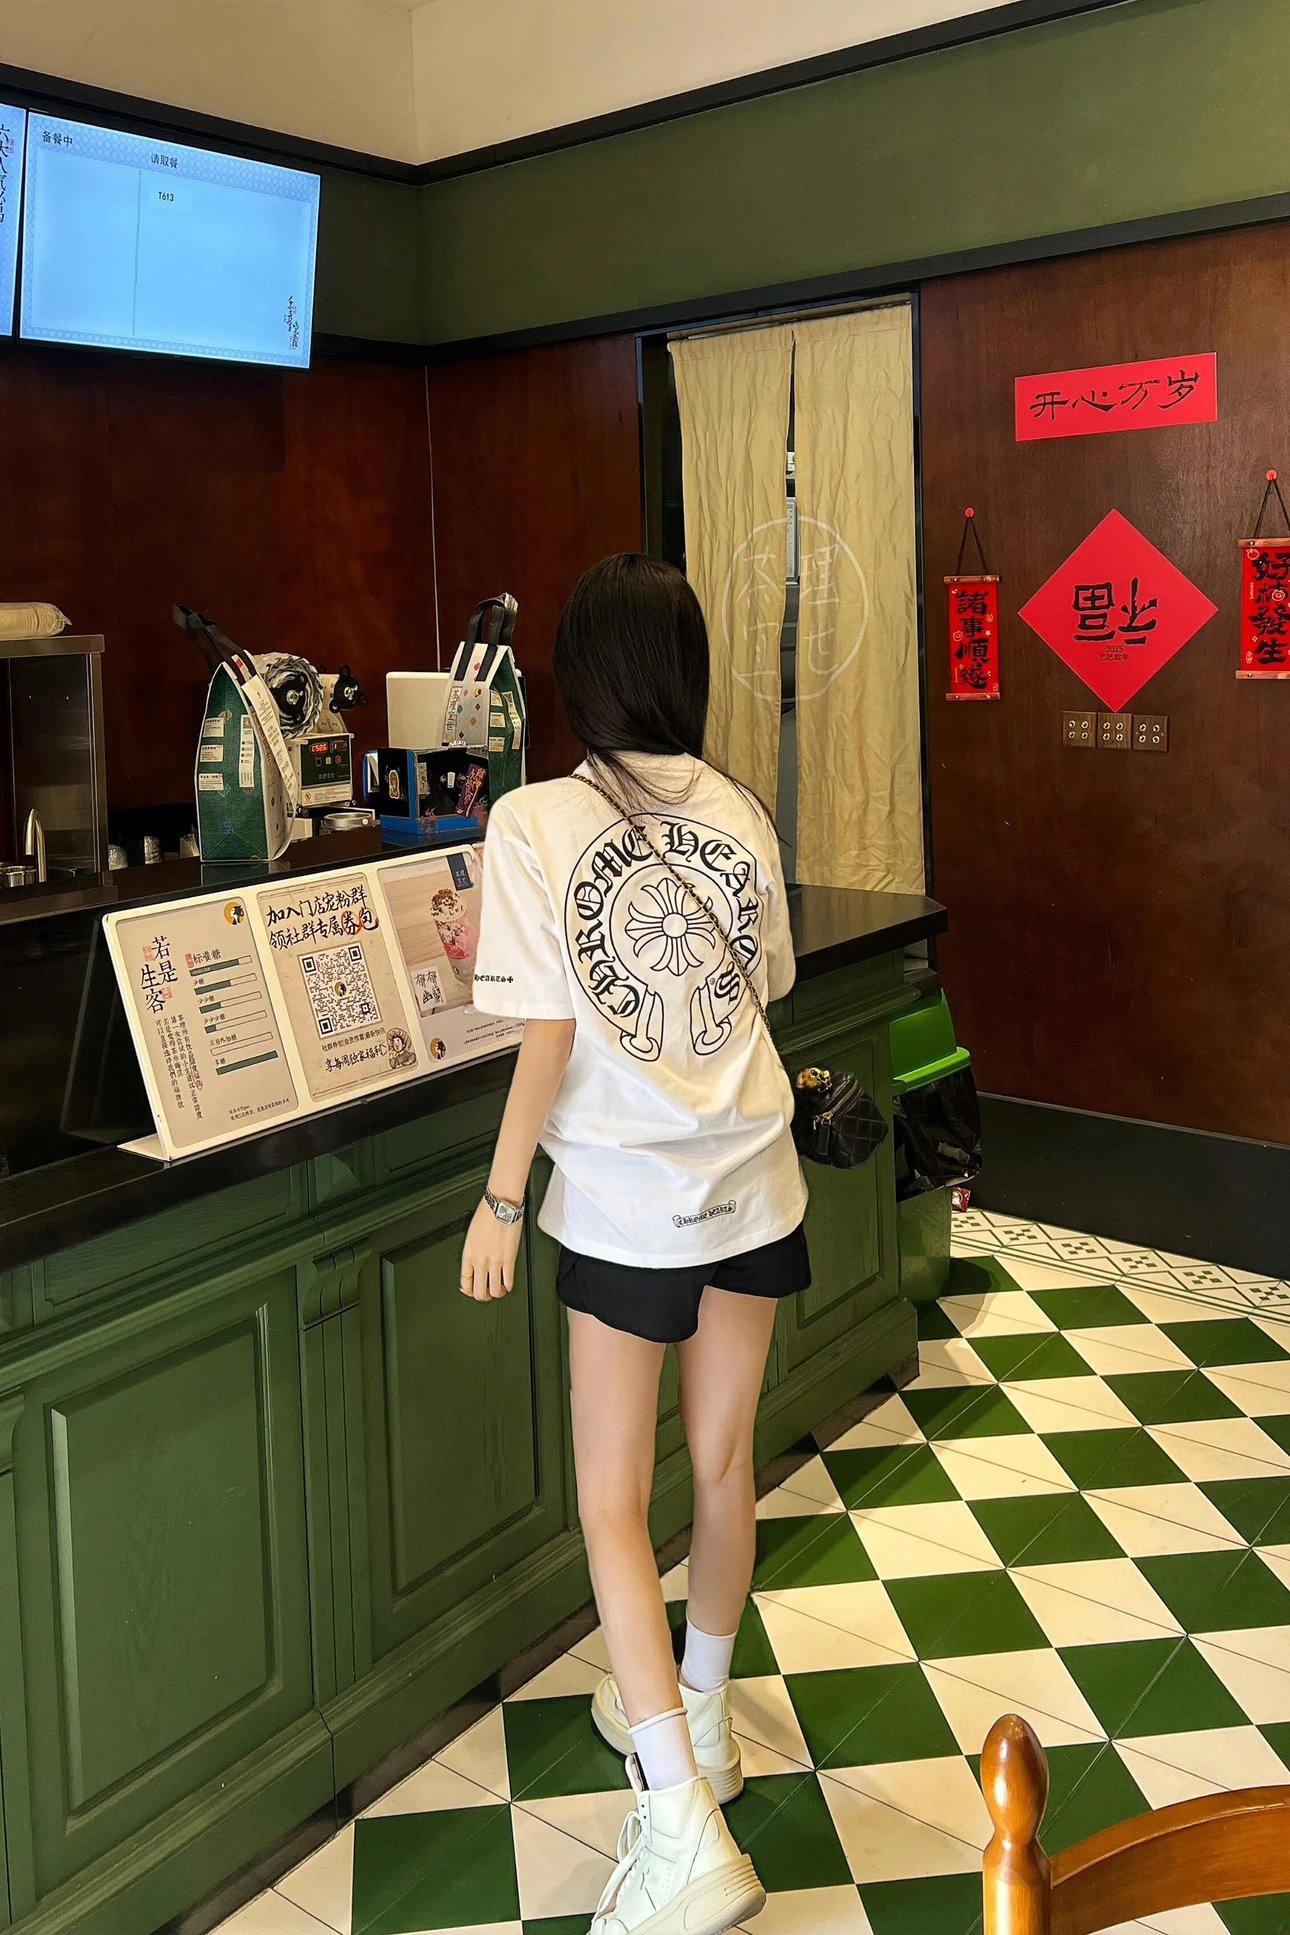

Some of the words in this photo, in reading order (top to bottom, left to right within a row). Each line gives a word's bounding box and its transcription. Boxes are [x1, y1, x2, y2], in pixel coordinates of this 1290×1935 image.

[42, 130, 73, 147] 备餐中
[150, 153, 179, 169] 请取餐
[158, 191, 174, 202] T613
[1030, 369, 1200, 421] 开心万岁
[1072, 576, 1158, 646] 福
[1105, 645, 1123, 653] 2025
[267, 885, 368, 927] 加入门店宠粉群
[269, 906, 379, 951] 领社群专属券包
